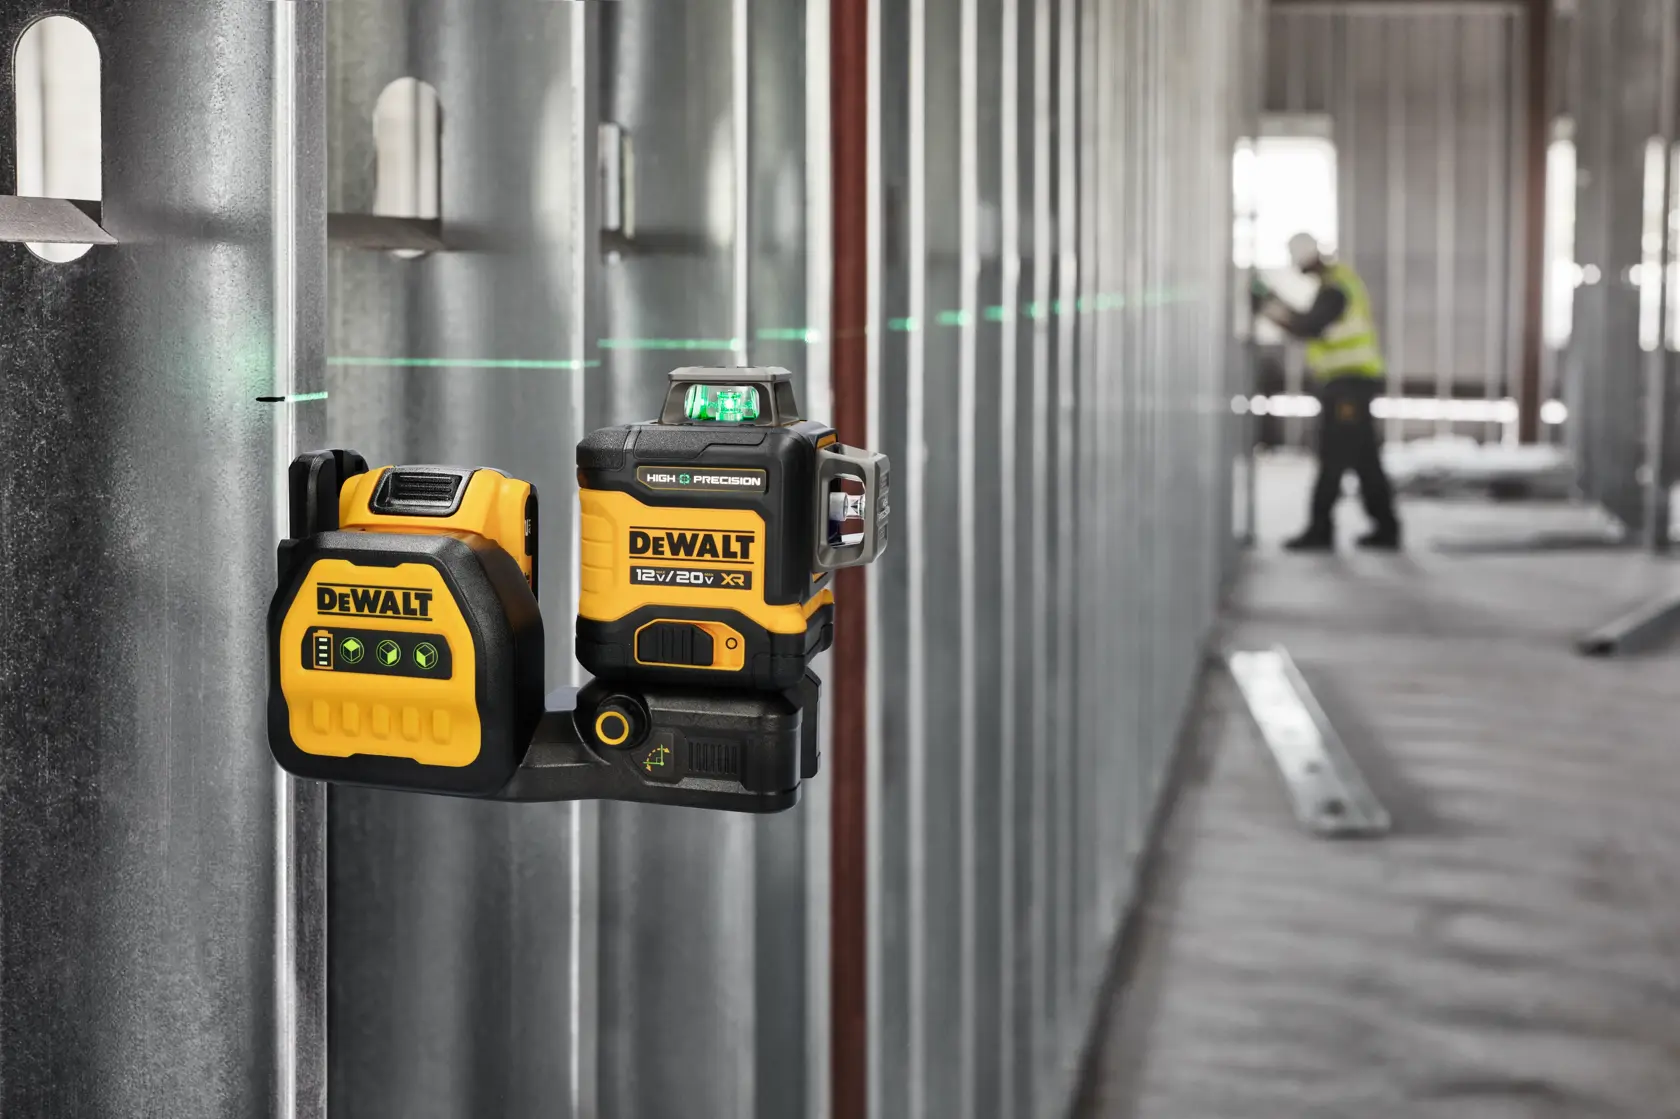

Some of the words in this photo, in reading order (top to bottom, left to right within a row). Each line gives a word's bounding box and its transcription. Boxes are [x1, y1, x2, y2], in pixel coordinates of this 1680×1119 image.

[646, 473, 676, 483] HIGH
[693, 476, 761, 486] PRECISION
[720, 572, 745, 586] XR
